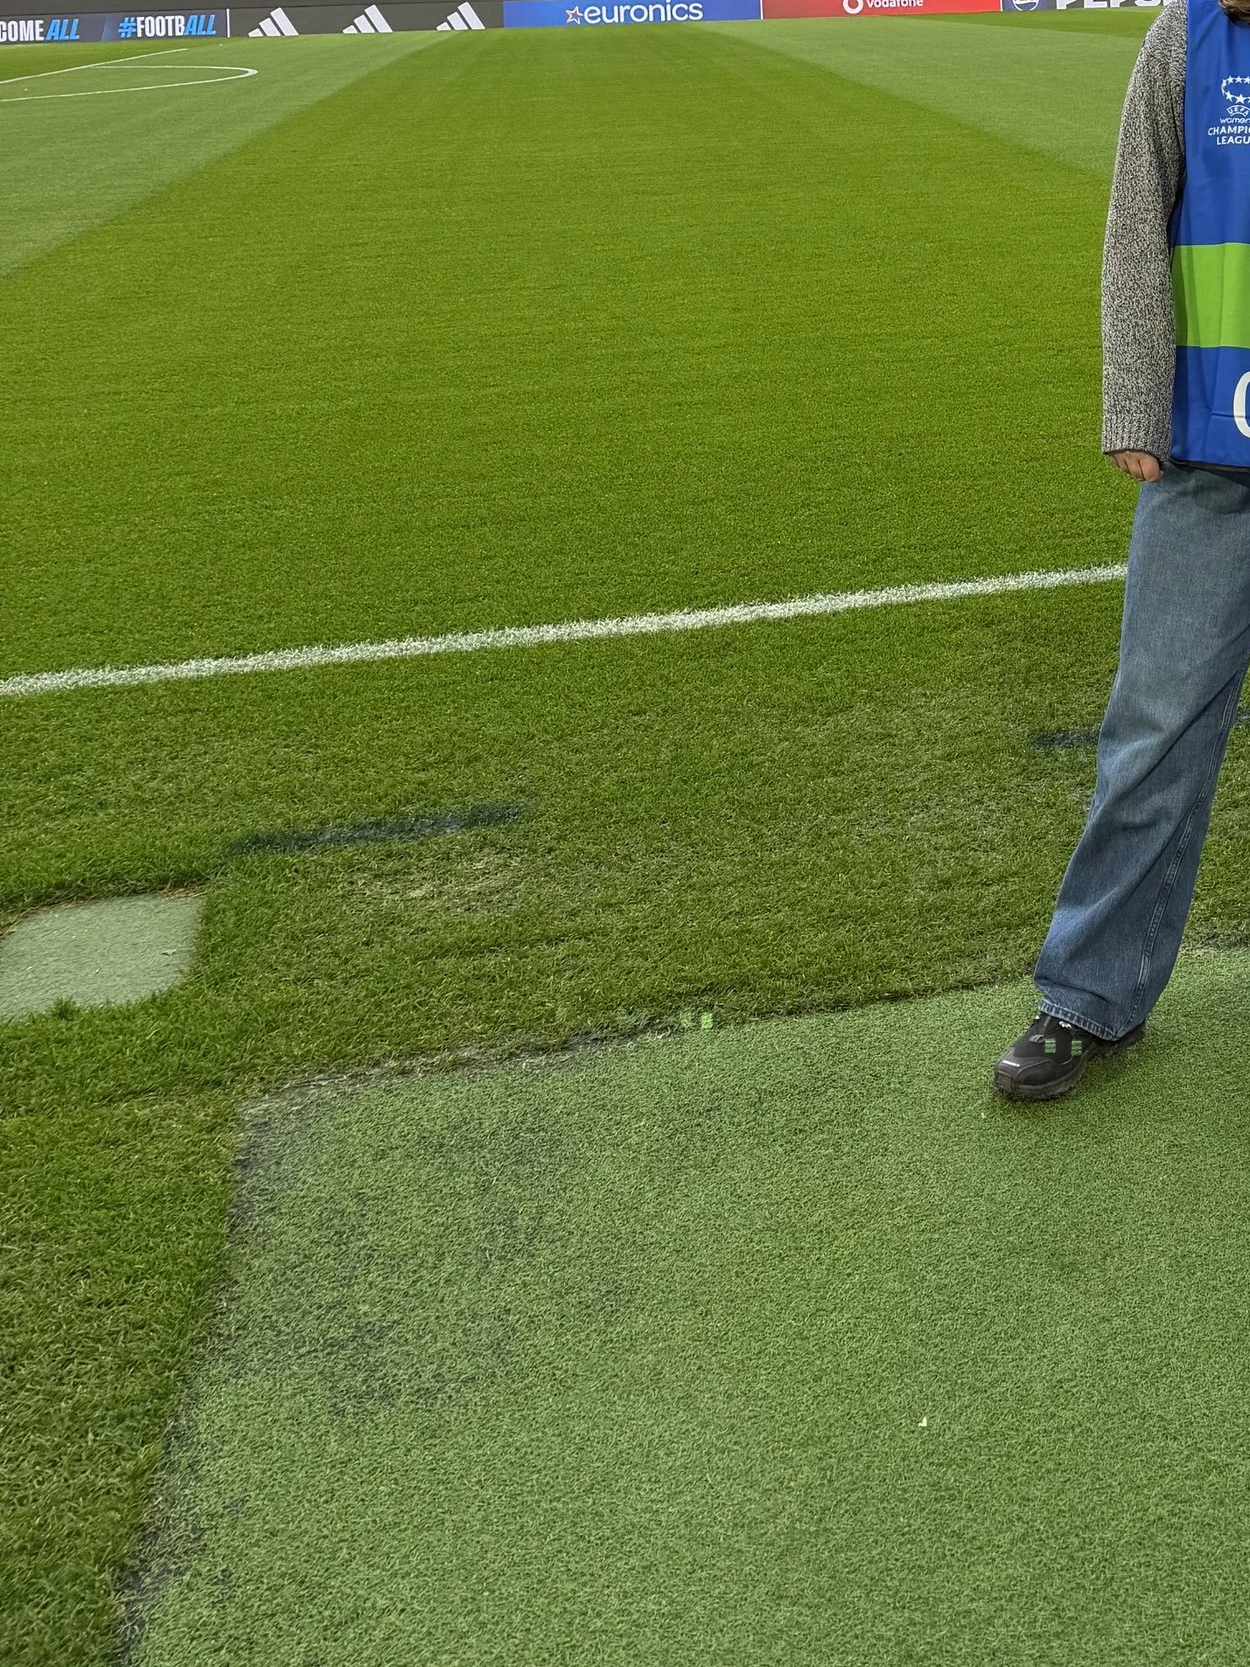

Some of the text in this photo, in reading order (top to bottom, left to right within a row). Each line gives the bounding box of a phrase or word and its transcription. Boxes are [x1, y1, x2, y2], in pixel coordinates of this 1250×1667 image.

[0, 18, 80, 43] COME ALL
[118, 14, 217, 38] #FOOTBALL
[1228, 106, 1250, 115] UEFA
